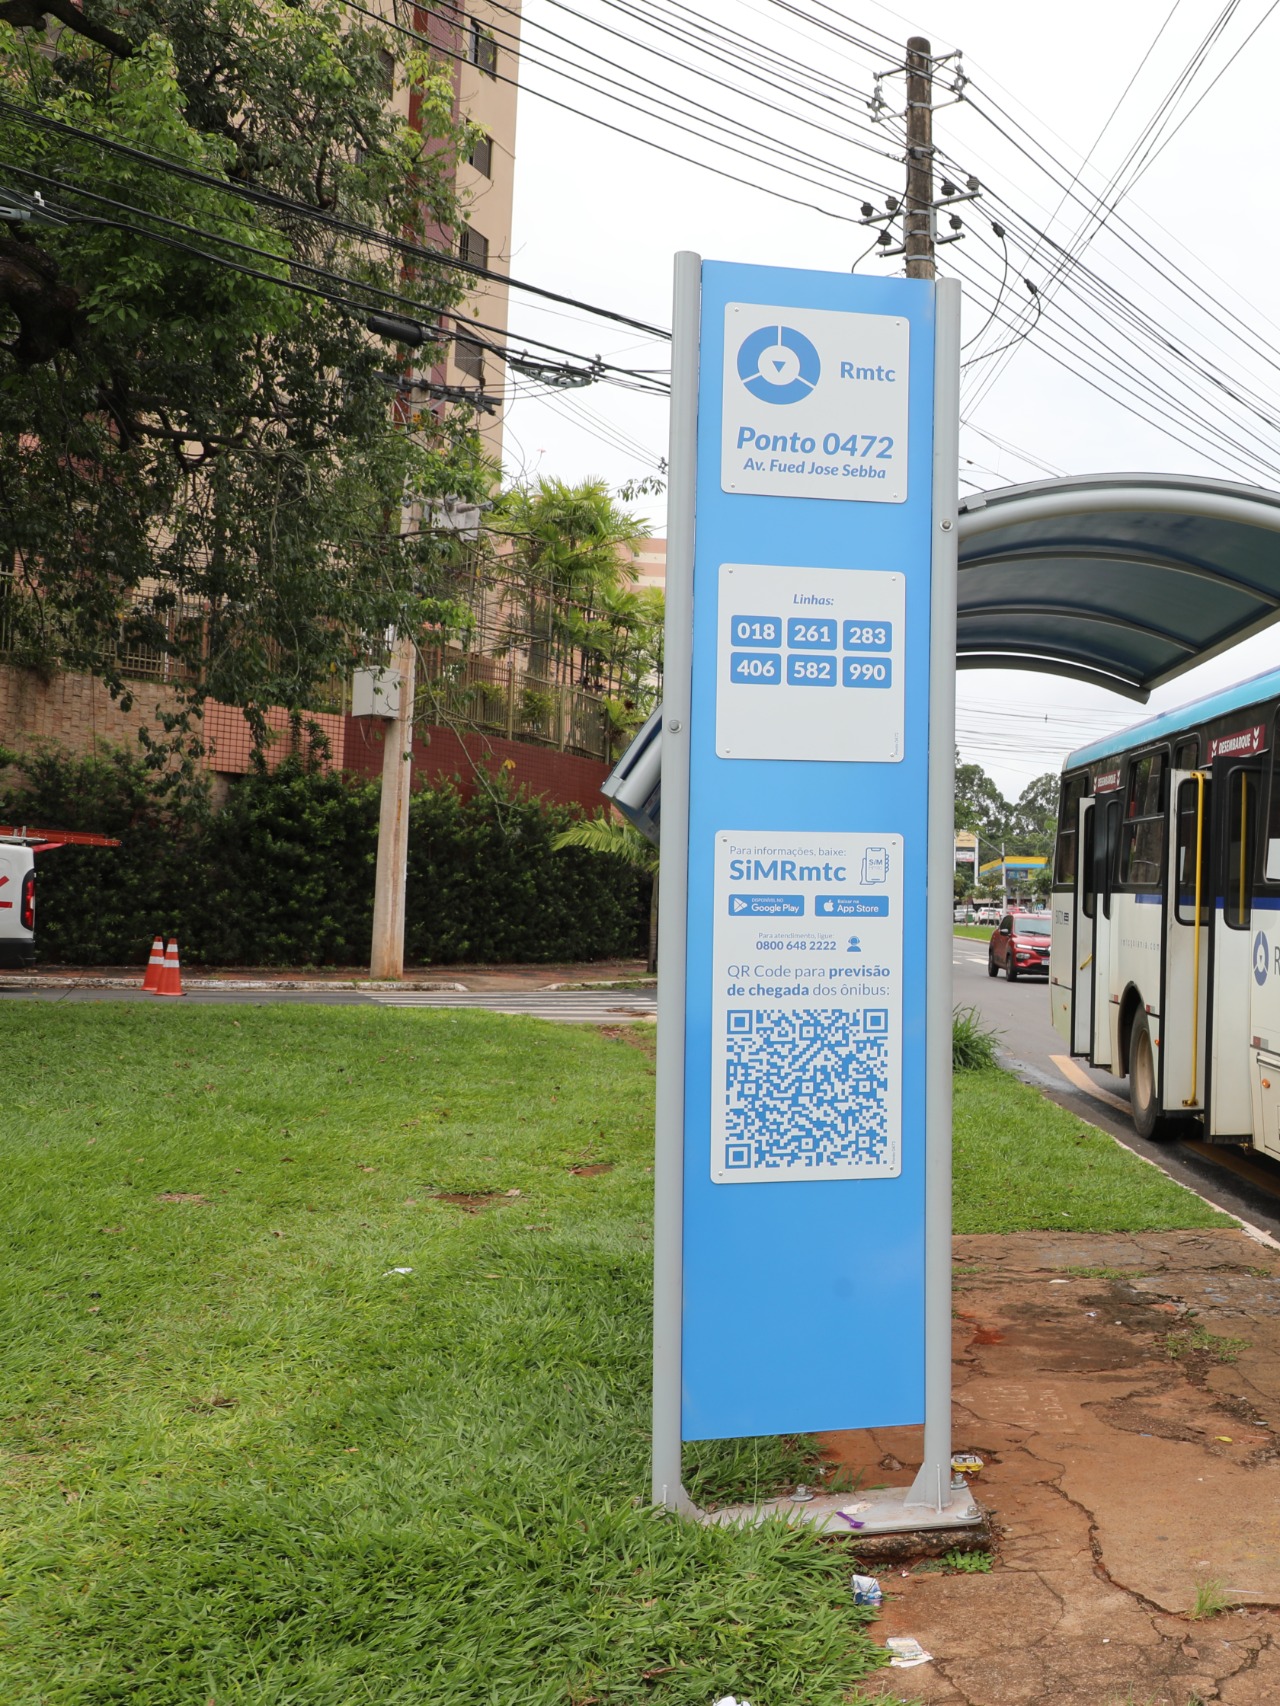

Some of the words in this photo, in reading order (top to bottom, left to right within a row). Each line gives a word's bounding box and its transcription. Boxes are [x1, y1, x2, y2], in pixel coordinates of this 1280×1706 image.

[840, 361, 896, 382] Rmtc
[736, 426, 816, 454] Ponto
[823, 433, 894, 459] 0472
[743, 458, 766, 472] Av.
[770, 459, 805, 474] Fued
[807, 461, 839, 476] Jose
[842, 464, 886, 479] Sebba
[793, 594, 834, 606] Linhas:
[737, 622, 776, 640] 018
[794, 625, 831, 642] 261
[849, 627, 886, 645] 283
[736, 660, 775, 677] 406
[793, 661, 831, 679] 582
[849, 664, 886, 681] 990
[1218, 733, 1252, 755] DESEMBARQUE
[729, 845, 752, 855] Para
[754, 846, 817, 857] informações,
[818, 847, 847, 857] baixe:
[729, 859, 847, 882] SiMRmtc
[751, 904, 782, 914] Google
[783, 904, 800, 913] Play
[837, 904, 854, 913] App
[857, 904, 879, 913] Store
[756, 941, 784, 951] 0800
[786, 941, 807, 951] 648
[809, 941, 837, 951] 2222
[727, 965, 750, 980] QR
[754, 965, 791, 978] Code
[794, 968, 825, 980] para
[829, 965, 891, 980] previsão
[727, 984, 745, 996] de
[748, 984, 809, 999] chegada
[812, 984, 837, 996] dos
[840, 984, 890, 996] ônibus:
